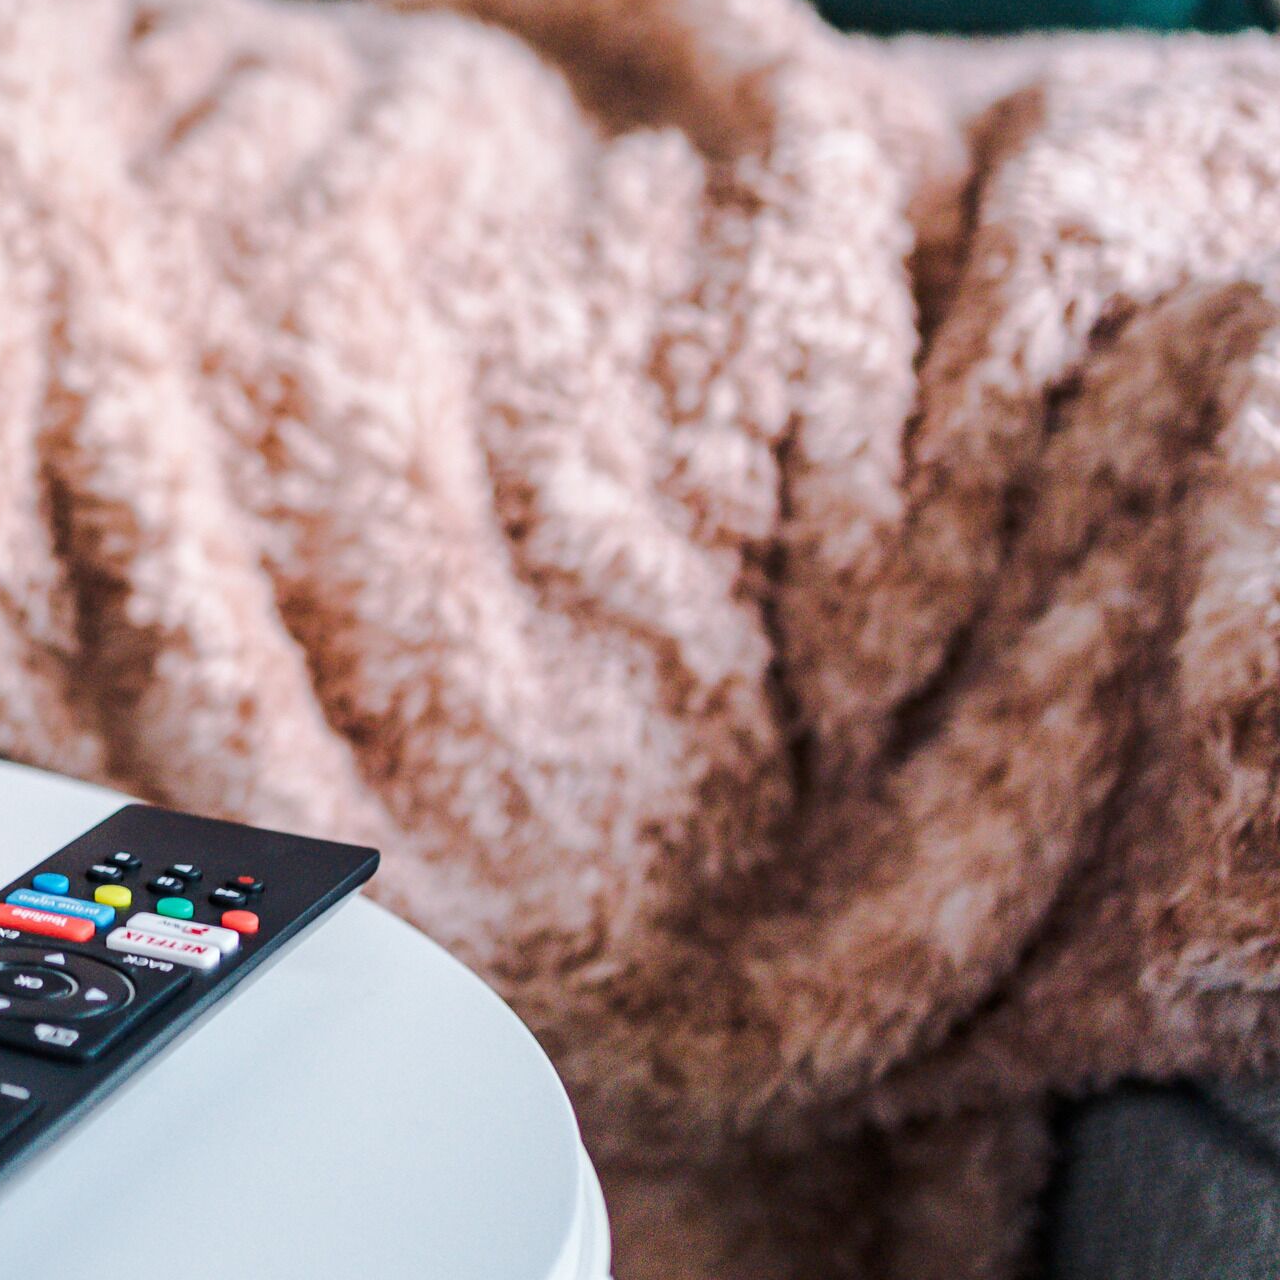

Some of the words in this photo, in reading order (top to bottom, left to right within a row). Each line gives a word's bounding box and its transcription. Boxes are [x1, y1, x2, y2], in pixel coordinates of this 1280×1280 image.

[11, 907, 68, 928] YouTube
[120, 929, 208, 956] NETFLIX
[122, 953, 175, 972] BACK
[13, 973, 44, 990] OK
